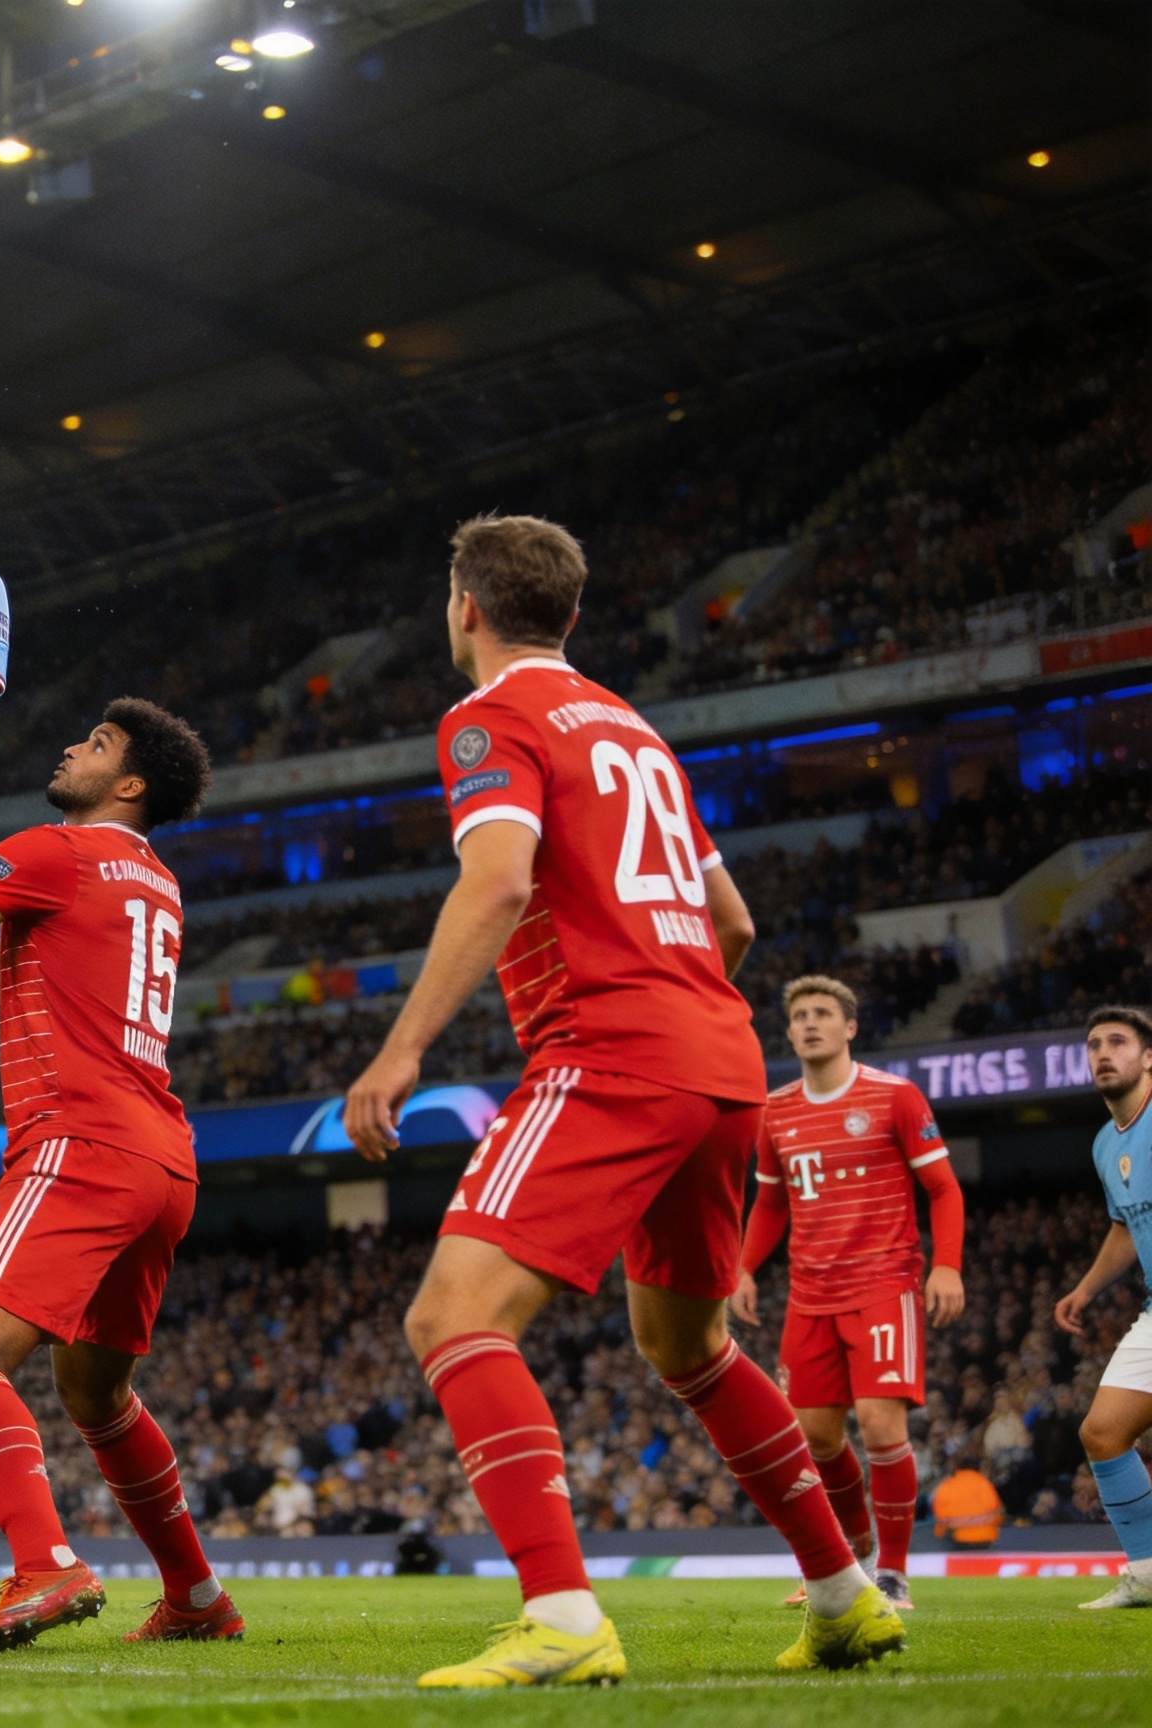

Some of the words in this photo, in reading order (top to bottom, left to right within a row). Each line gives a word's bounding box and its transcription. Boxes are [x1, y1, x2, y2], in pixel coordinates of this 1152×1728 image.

[591, 740, 706, 907] 28
[124, 898, 181, 1035] 15
[869, 1324, 895, 1362] 17
